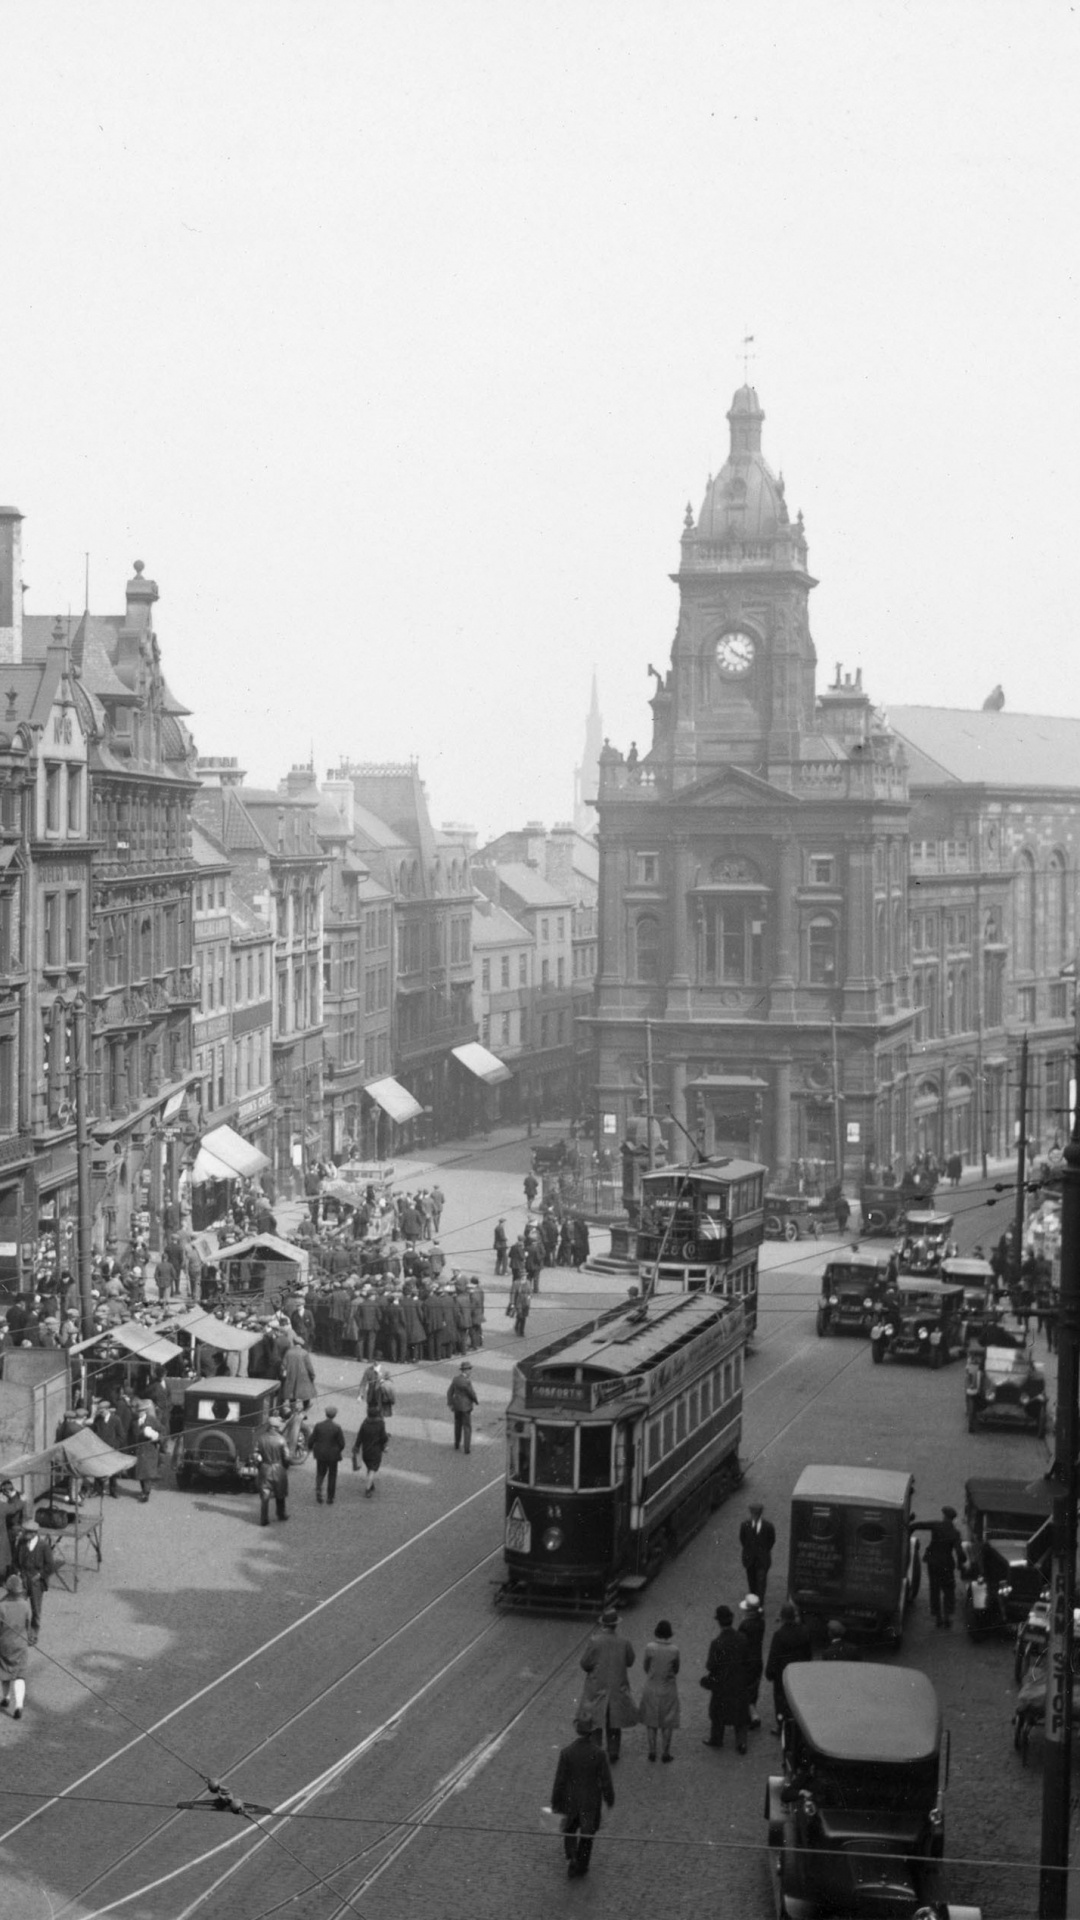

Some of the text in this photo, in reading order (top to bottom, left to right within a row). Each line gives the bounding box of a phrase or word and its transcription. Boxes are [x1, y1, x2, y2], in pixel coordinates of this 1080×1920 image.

[532, 1386, 584, 1400] GOSFORTH
[1052, 1552, 1066, 1735] TRAM STOP
